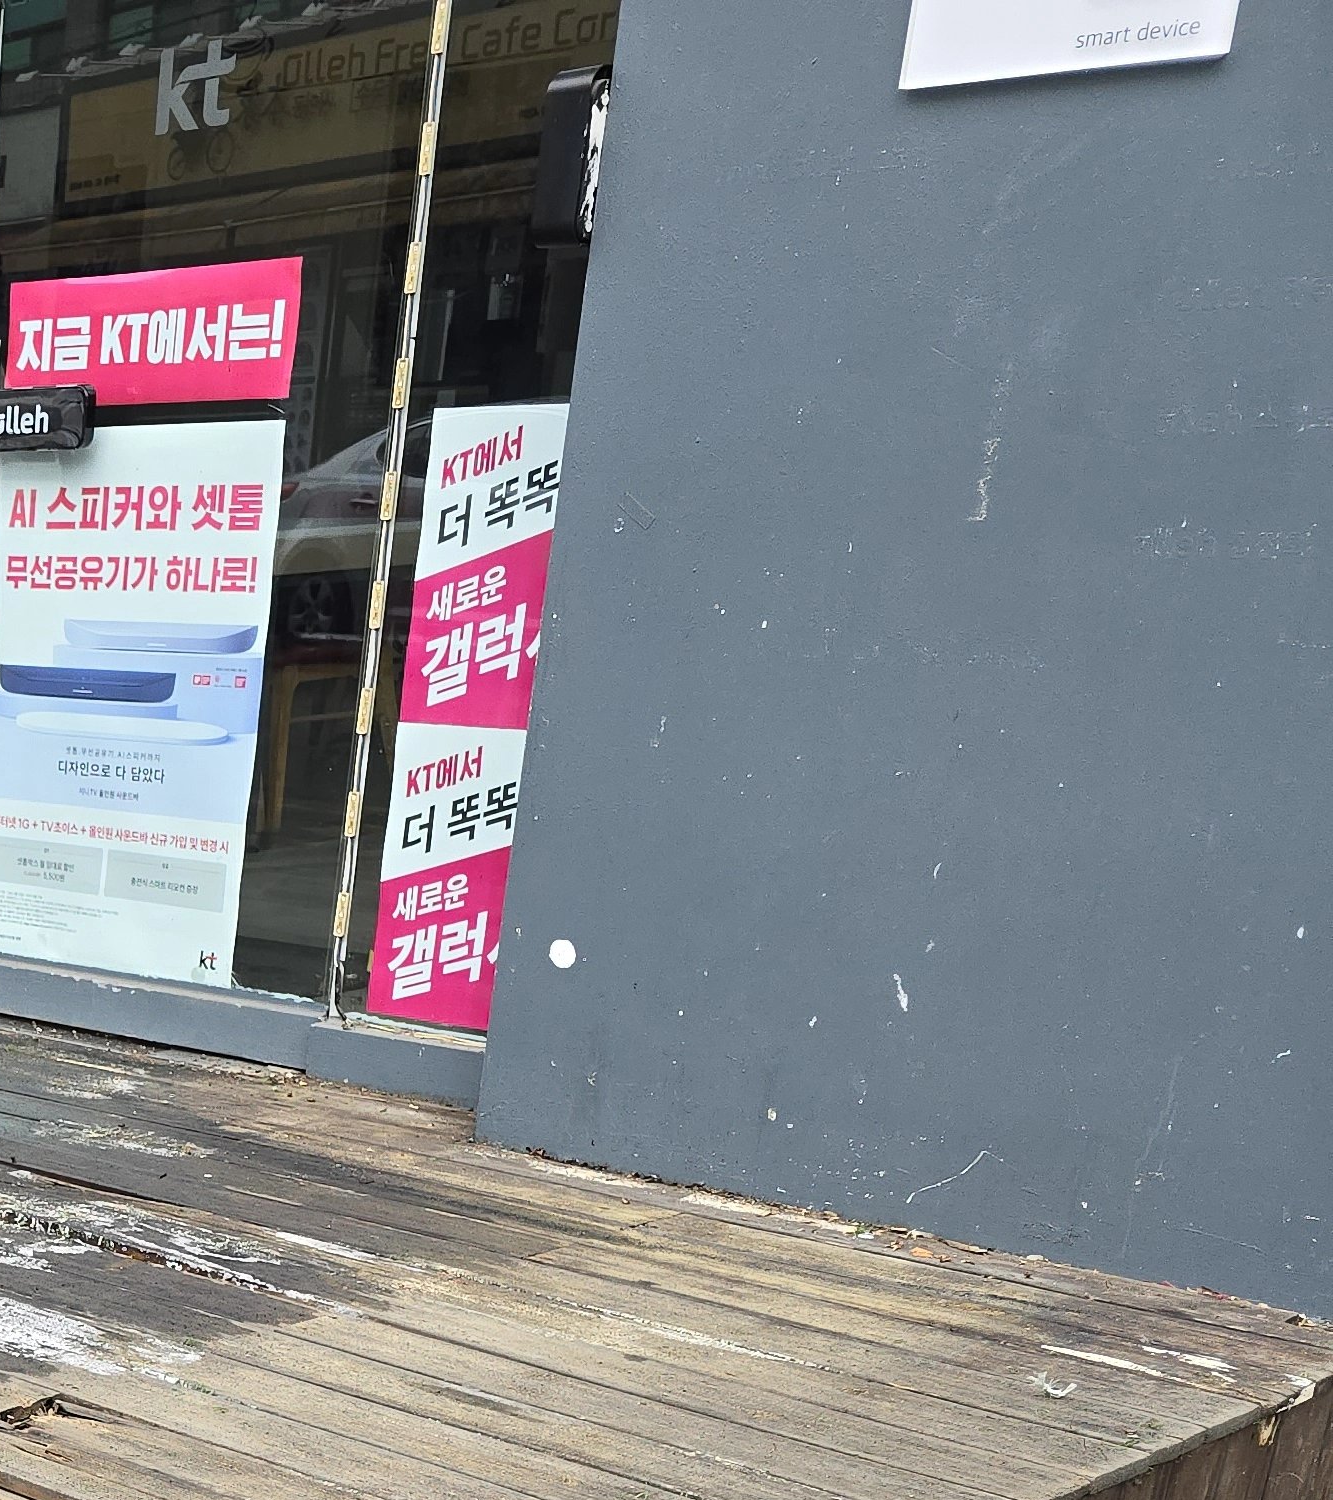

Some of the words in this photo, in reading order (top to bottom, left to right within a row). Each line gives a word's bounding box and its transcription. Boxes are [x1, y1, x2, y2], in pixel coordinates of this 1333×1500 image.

[461, 15, 542, 59] Cafe
[1075, 27, 1131, 49] smart
[1137, 18, 1202, 41] device
[154, 39, 237, 136] kt
[15, 316, 91, 372] 지금
[100, 299, 286, 365] KT에서는!
[440, 425, 524, 489] KT에서
[9, 488, 37, 528] AI
[45, 485, 182, 531] 스피커와
[191, 484, 264, 531] 셋톱
[437, 493, 473, 547] 더
[484, 459, 560, 529] 똑똑
[6, 556, 158, 591] 무선공유기가
[165, 556, 258, 593] 하나로!
[426, 565, 507, 621] 새로운
[421, 602, 541, 708] 갤럭
[58, 760, 111, 778] 디자인으로
[115, 765, 127, 781] 다
[131, 766, 165, 784] 담았다
[405, 745, 484, 798] KT에서
[18, 818, 30, 829] 1G
[40, 820, 79, 835] TV초이스
[89, 824, 113, 840] 올인원
[115, 828, 149, 844] 사운드바
[150, 832, 168, 847] 신규
[169, 834, 188, 849] 가입
[190, 837, 198, 851] 및
[200, 837, 218, 853] 변경
[219, 841, 230, 854] 시
[401, 804, 436, 853] 더
[447, 781, 518, 841] 똑똑
[392, 873, 469, 921] 새로운
[199, 951, 218, 970] kt
[387, 910, 500, 1001] 갤럭
